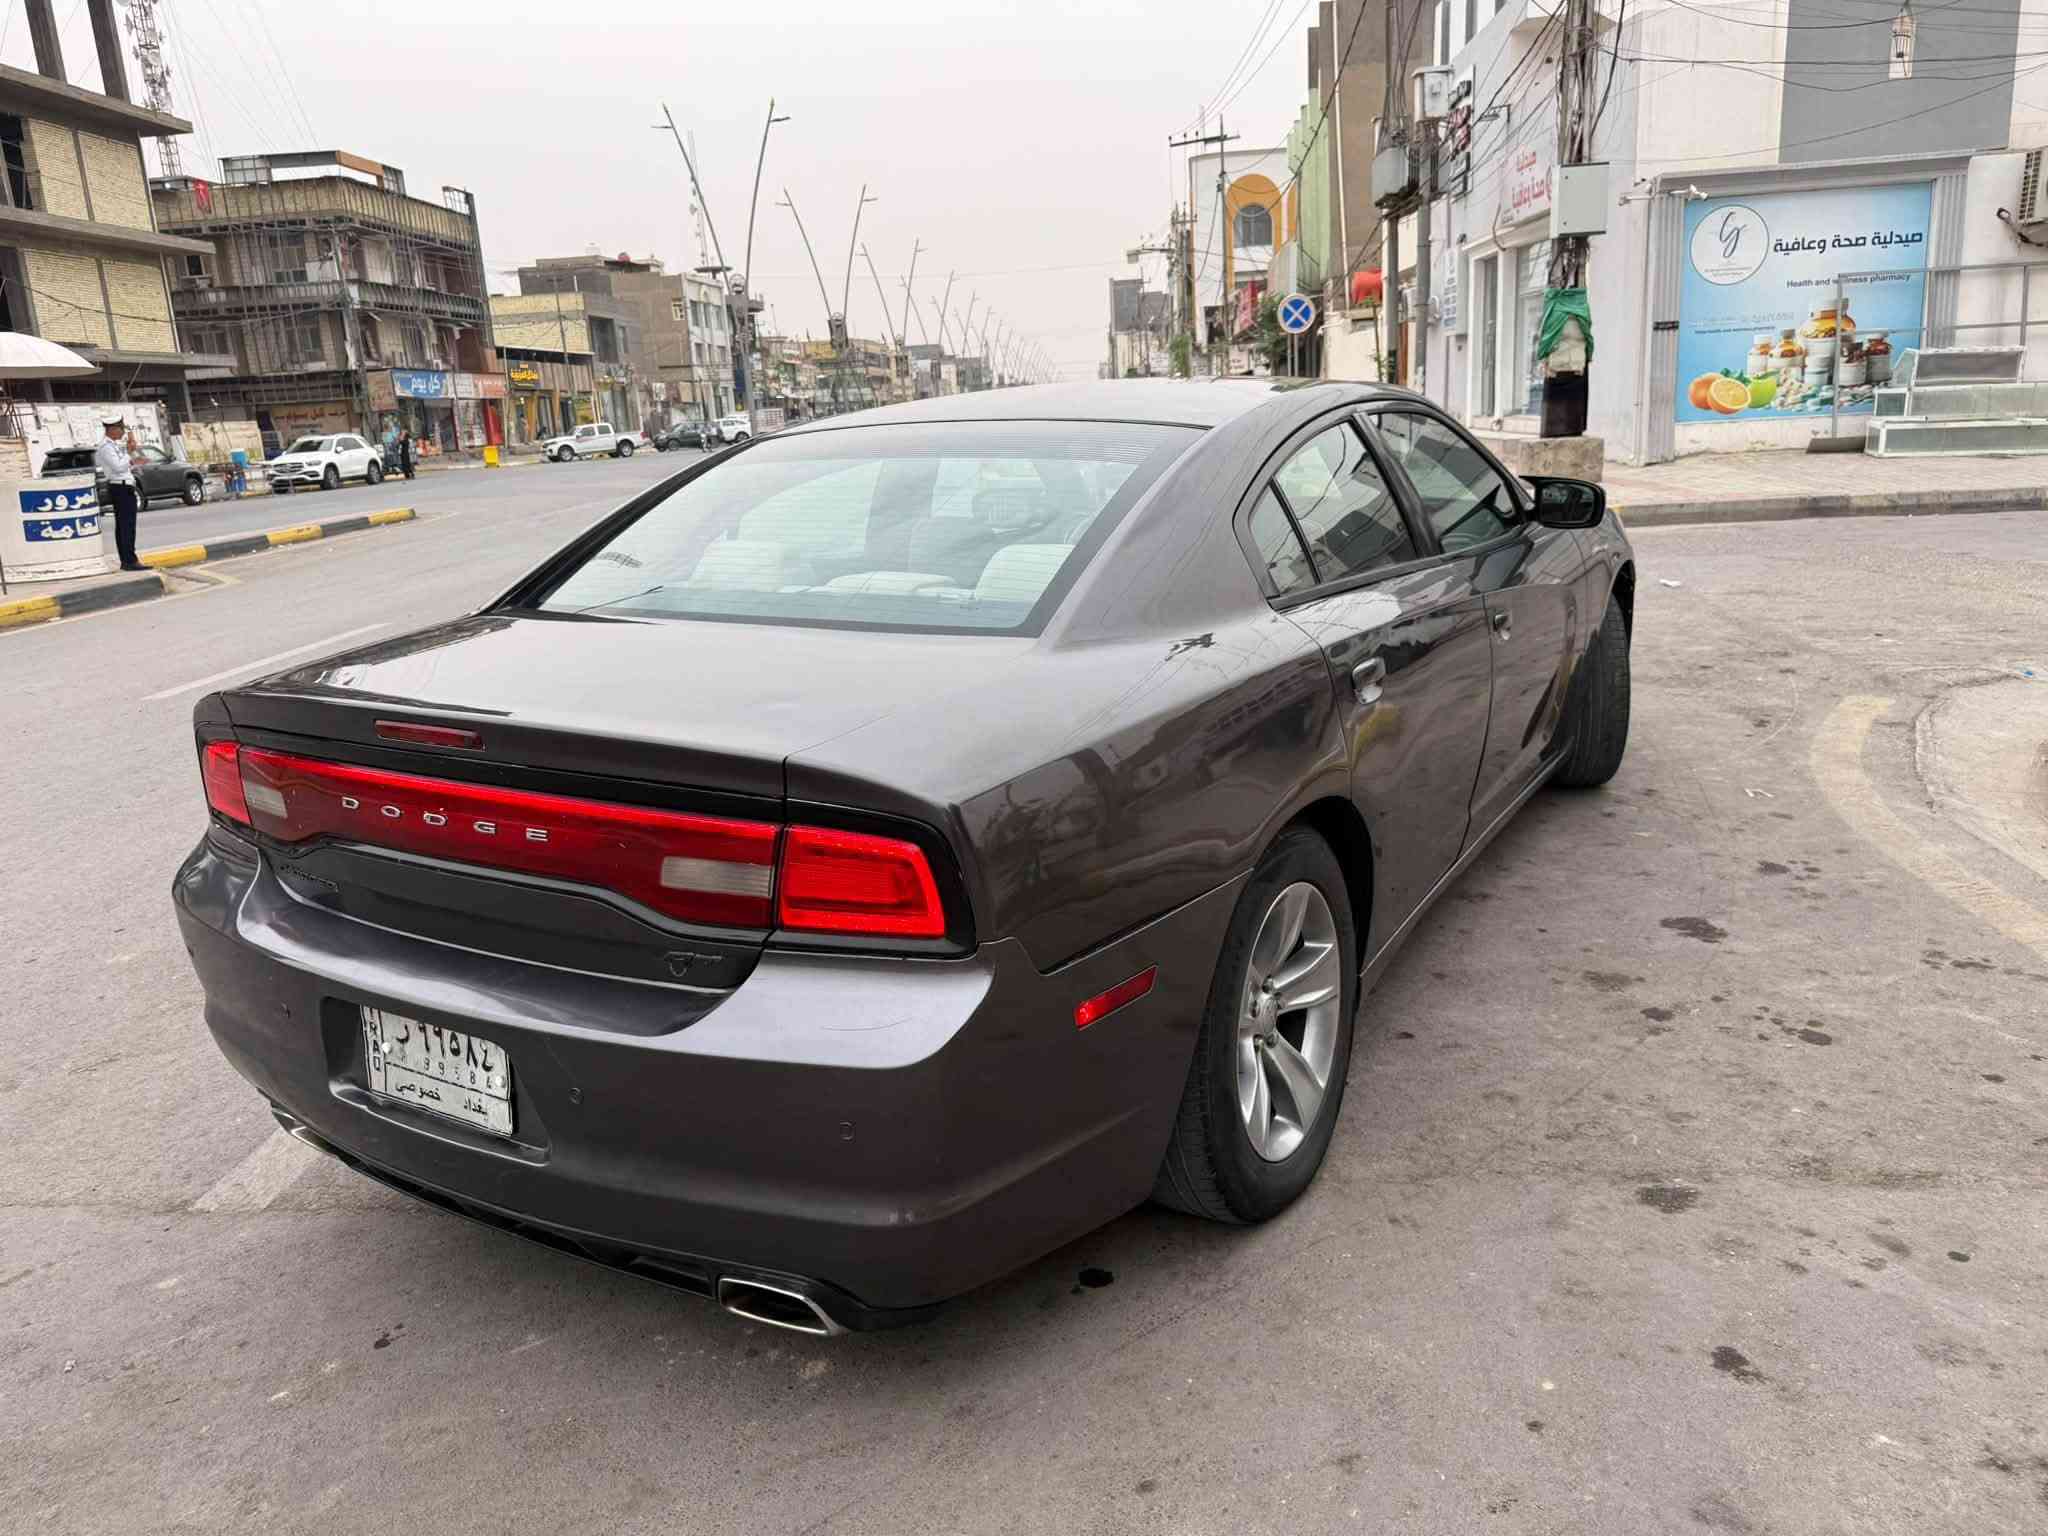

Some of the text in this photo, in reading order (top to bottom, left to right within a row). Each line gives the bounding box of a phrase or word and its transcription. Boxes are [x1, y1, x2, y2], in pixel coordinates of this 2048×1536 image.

[1773, 230, 1923, 255] صيدلية صحة وعافية
[1786, 271, 1911, 288] Health and wness pharmacy
[341, 796, 549, 842] DODGE
[395, 1081, 488, 1121] بغداد خصوصي
